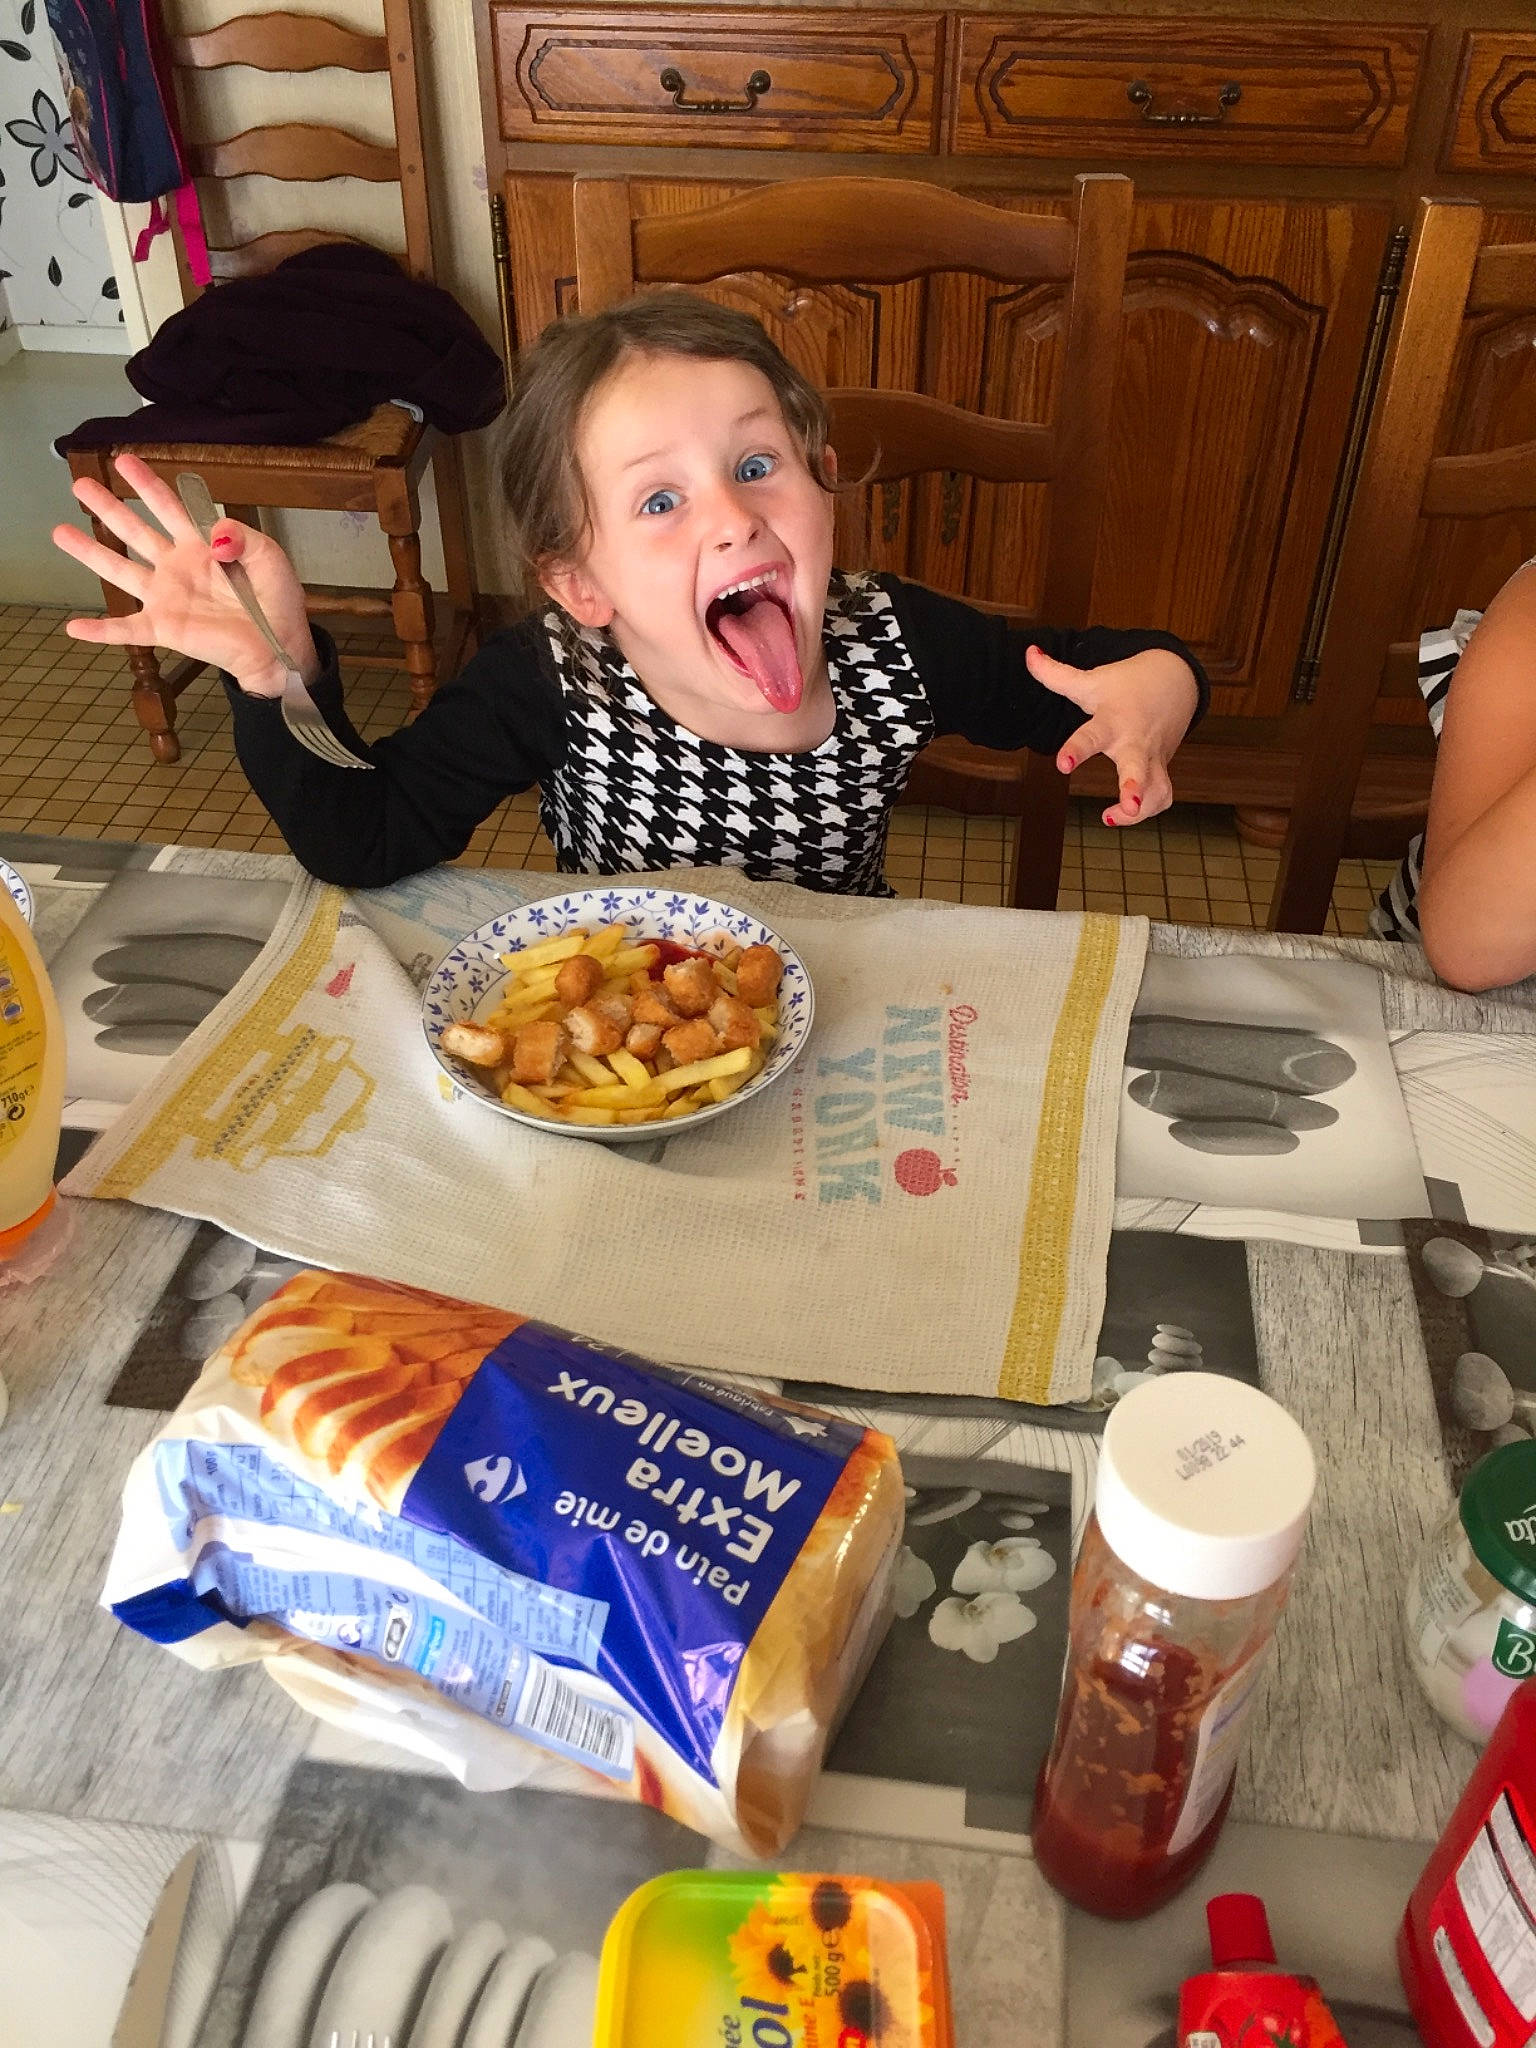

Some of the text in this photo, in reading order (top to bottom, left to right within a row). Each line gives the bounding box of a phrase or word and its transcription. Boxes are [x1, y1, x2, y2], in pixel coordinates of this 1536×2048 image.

[815, 1047, 882, 1204] YORK
[883, 1005, 945, 1136] NEW
[548, 1371, 801, 1512] Moelleux
[554, 1490, 751, 1606] Pain de mie
[626, 1457, 774, 1564] Extra
[1504, 1516, 1536, 1547] ta
[1496, 1633, 1536, 1675] B
